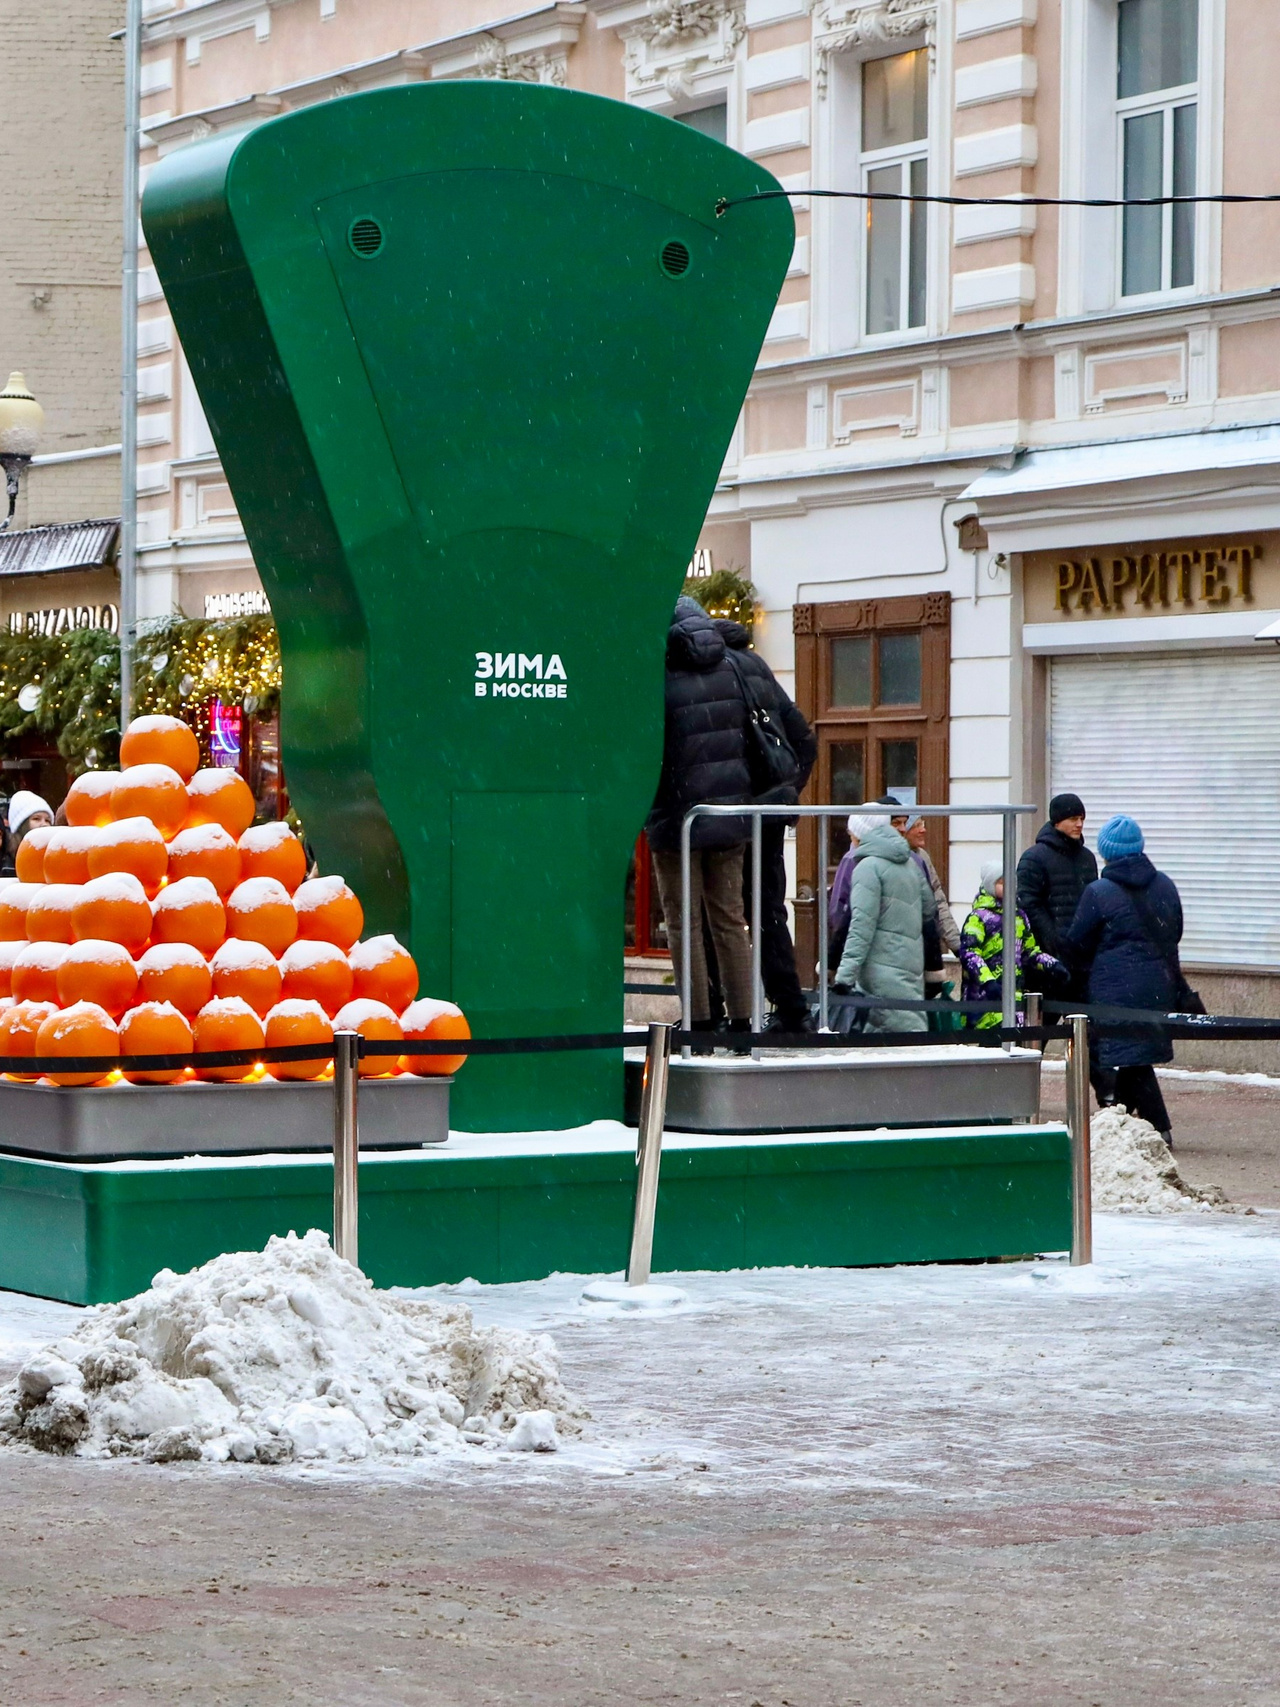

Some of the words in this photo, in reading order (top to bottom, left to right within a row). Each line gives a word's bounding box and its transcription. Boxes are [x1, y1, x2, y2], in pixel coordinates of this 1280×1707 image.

[1053, 546, 1255, 611] РАРИТЕТ
[204, 589, 272, 619] ИТАЛЬЯНСК
[474, 651, 568, 680] ЗИМА
[475, 682, 487, 697] В
[492, 682, 568, 698] МОСКВЕ
